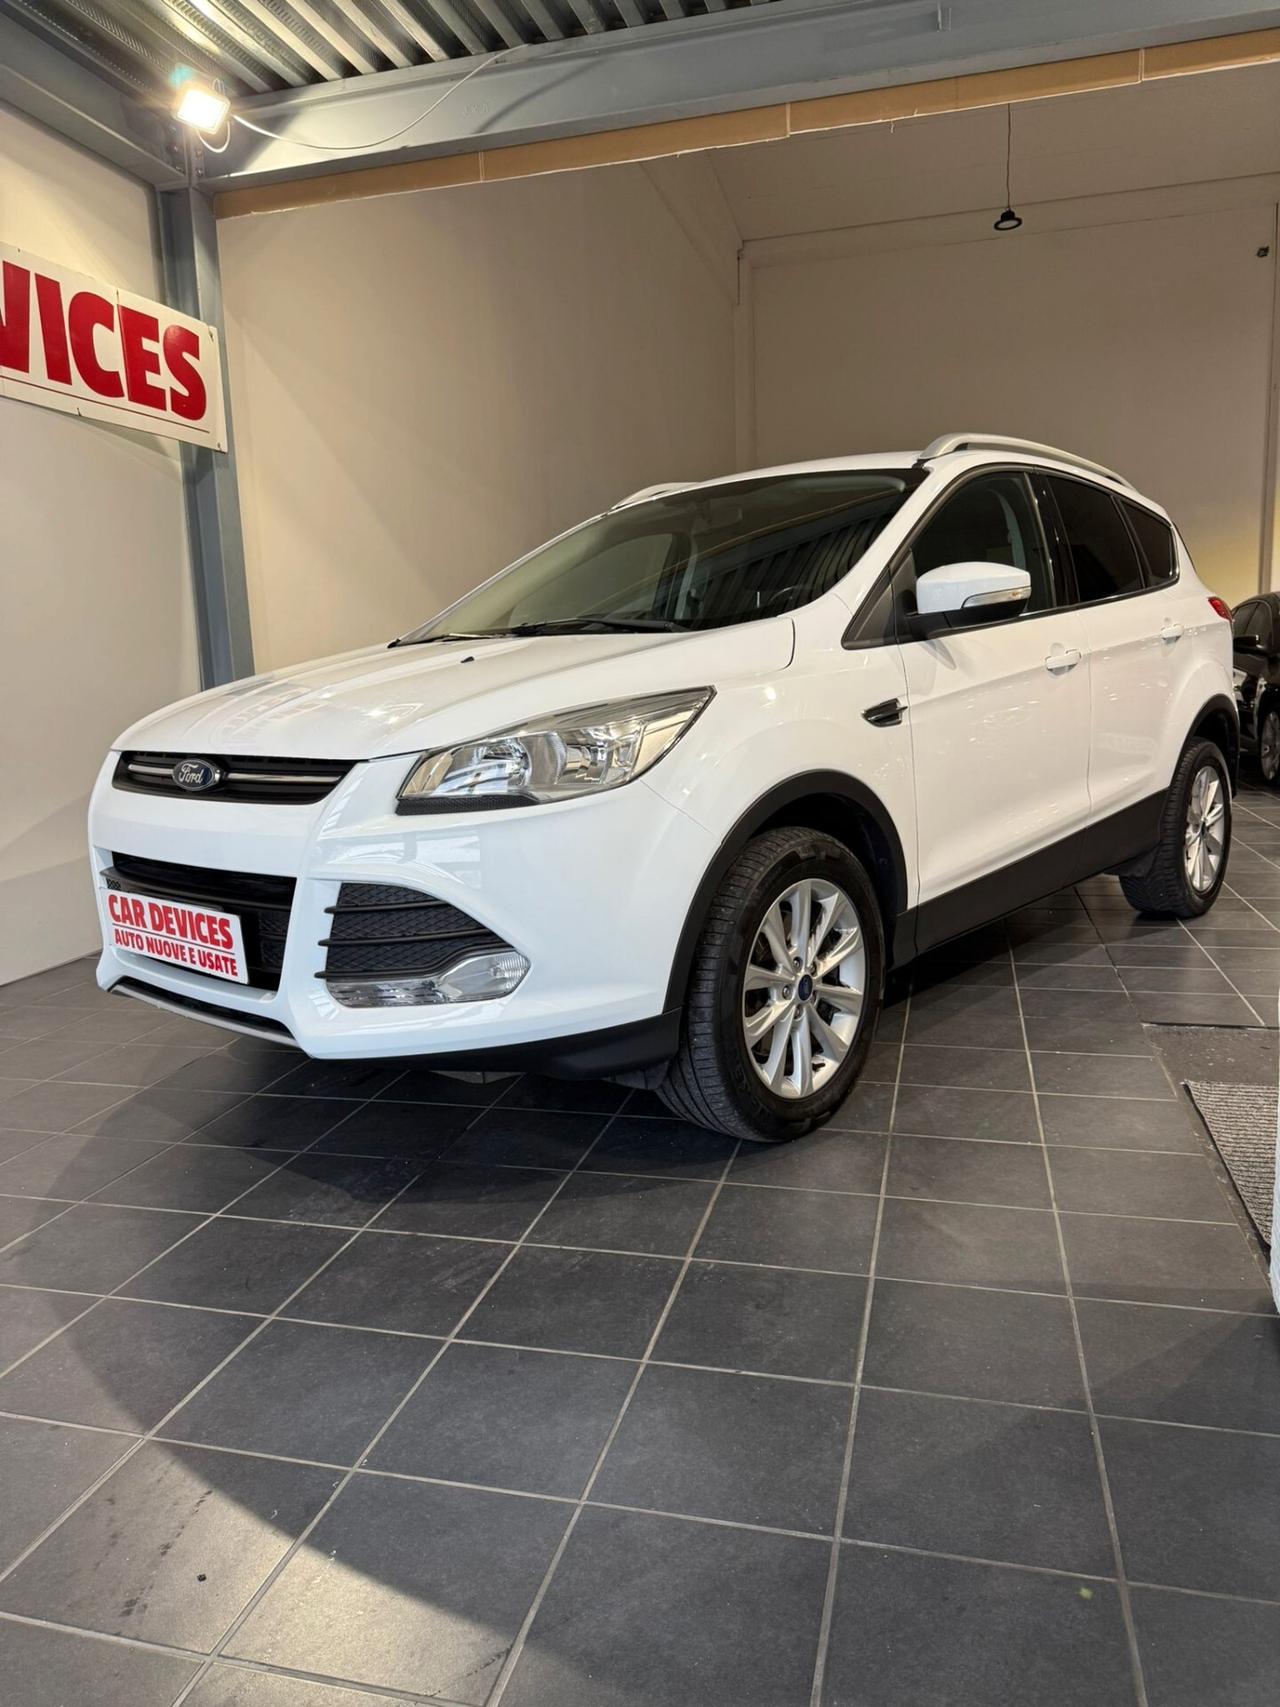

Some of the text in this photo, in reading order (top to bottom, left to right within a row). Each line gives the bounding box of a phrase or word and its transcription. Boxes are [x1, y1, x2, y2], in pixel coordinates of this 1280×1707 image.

[178, 763, 205, 784] Ford
[108, 894, 234, 950] CAR DEVICES
[114, 929, 238, 977] AUTO NUOVE E USATE
